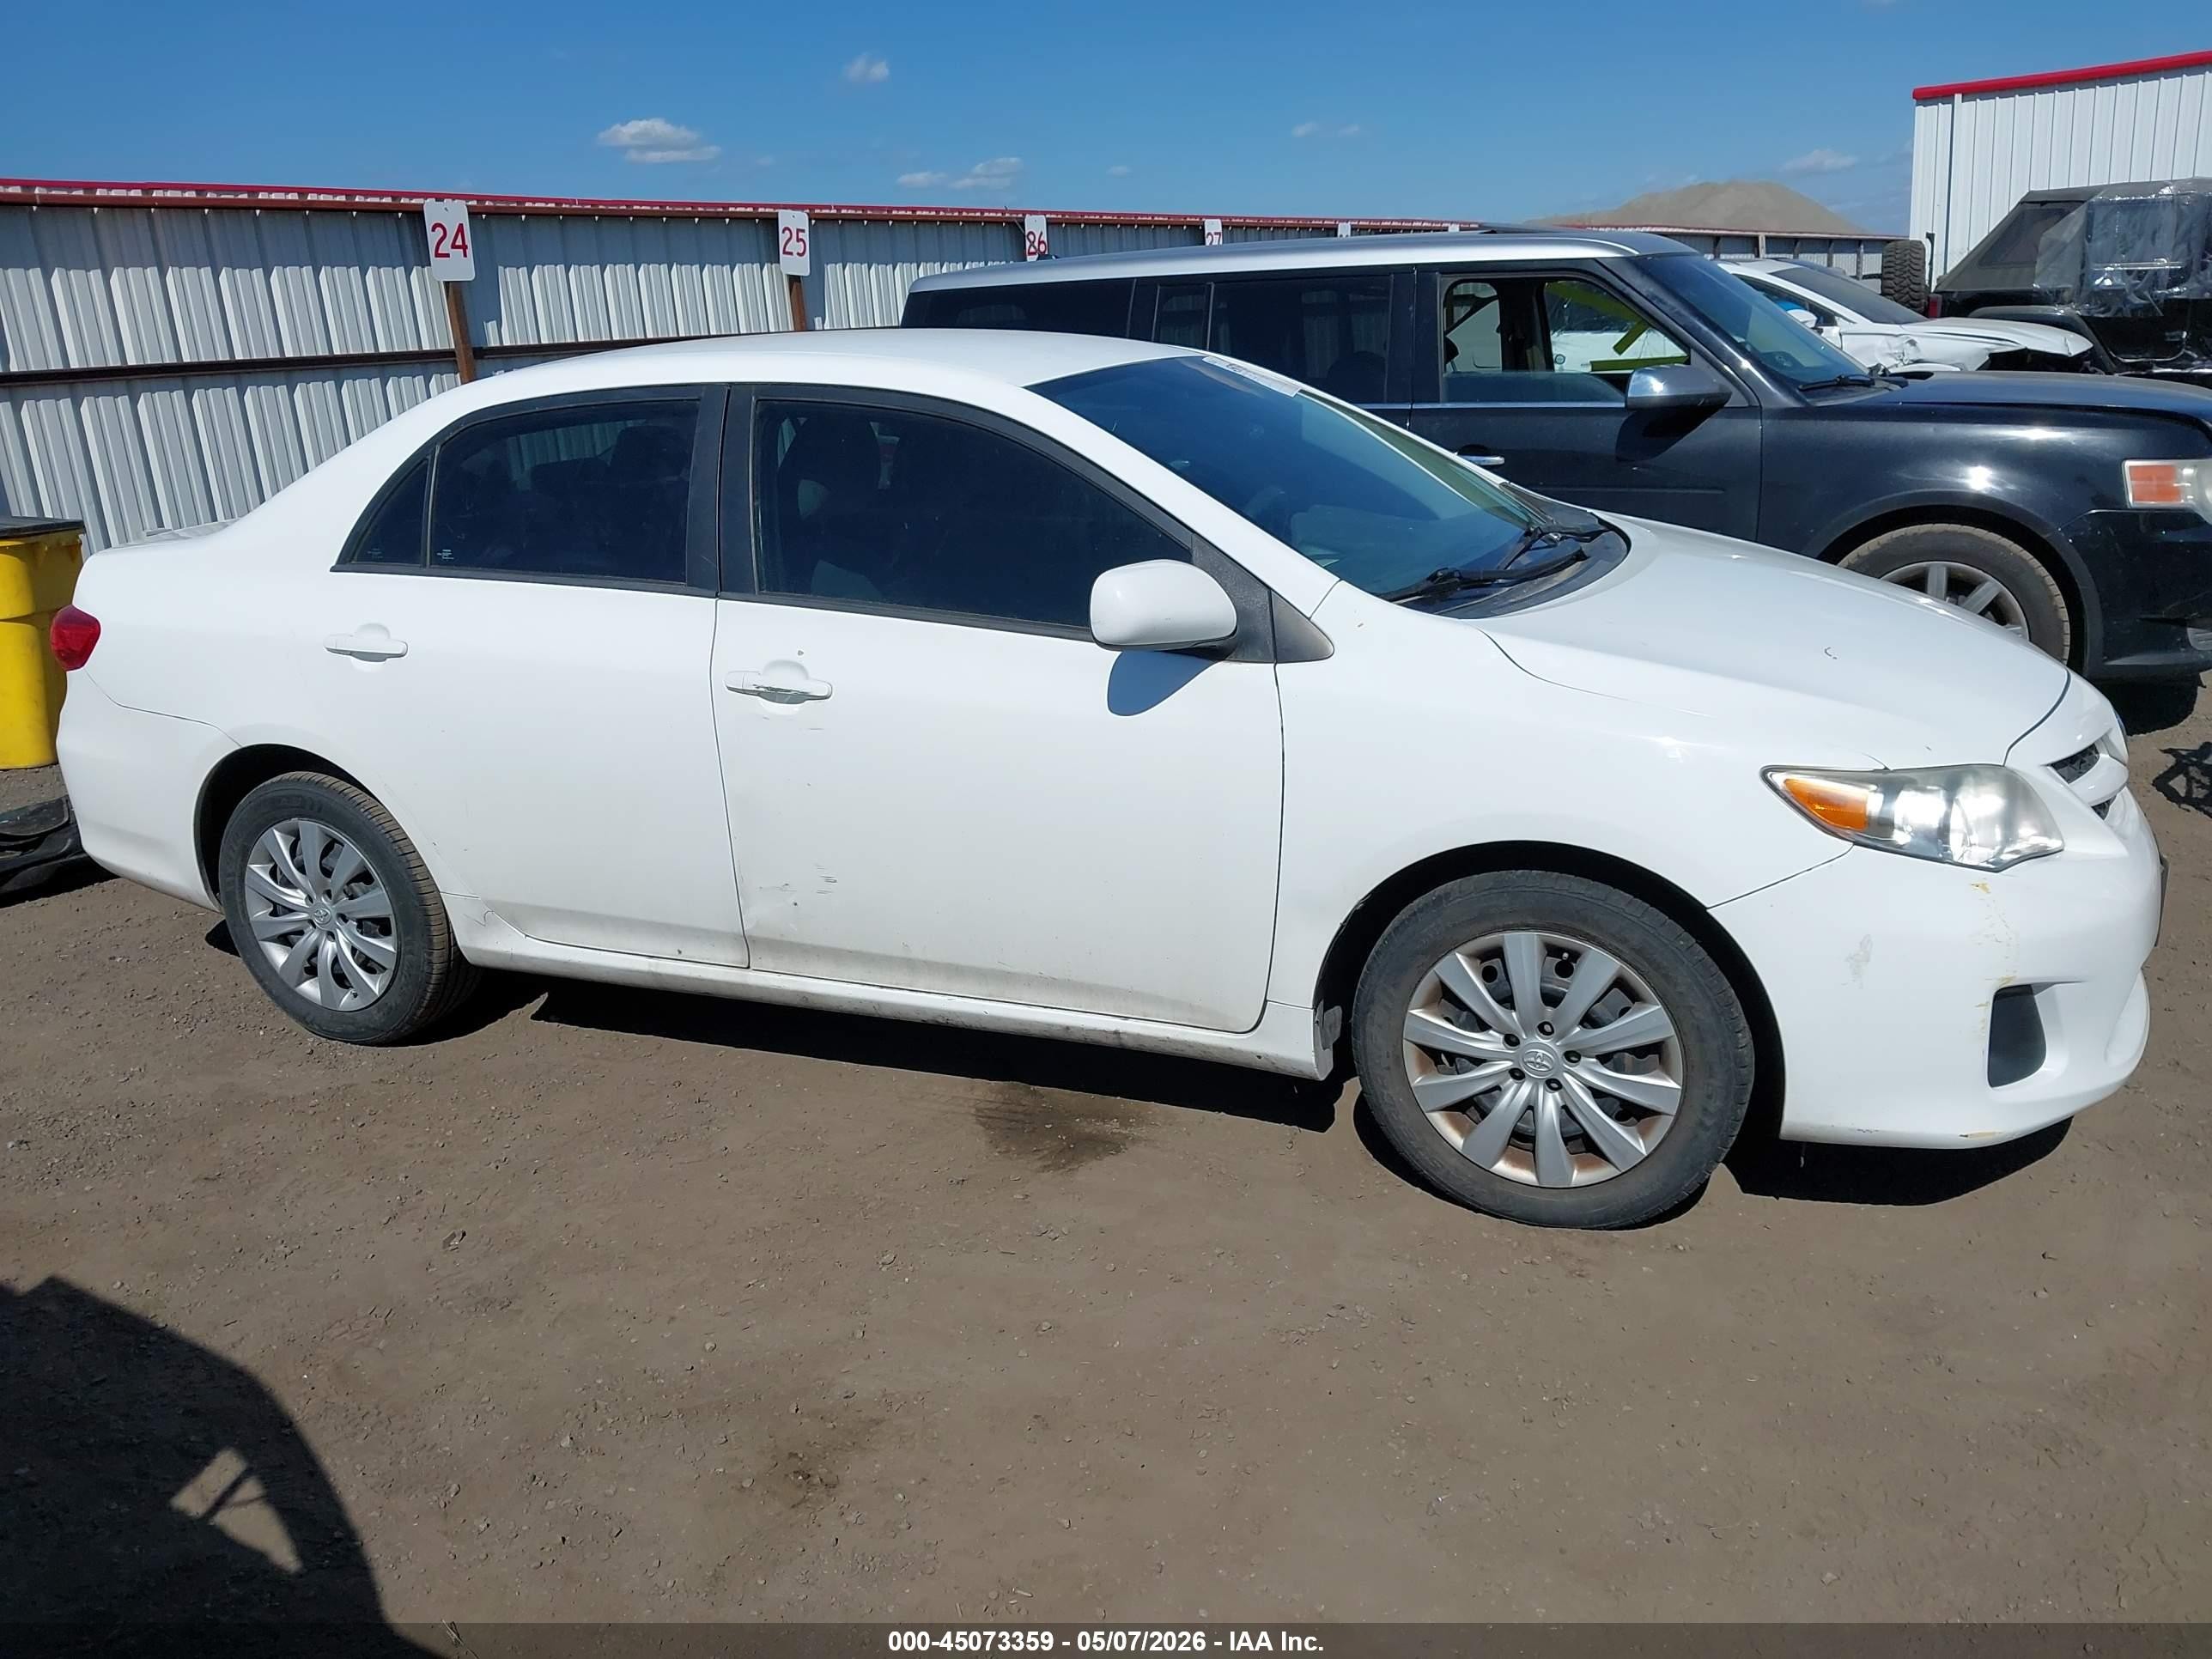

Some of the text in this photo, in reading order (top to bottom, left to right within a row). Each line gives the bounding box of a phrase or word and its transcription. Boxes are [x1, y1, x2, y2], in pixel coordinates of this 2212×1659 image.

[431, 222, 468, 258] 24
[782, 226, 807, 258] 25
[1206, 231, 1222, 246] 27
